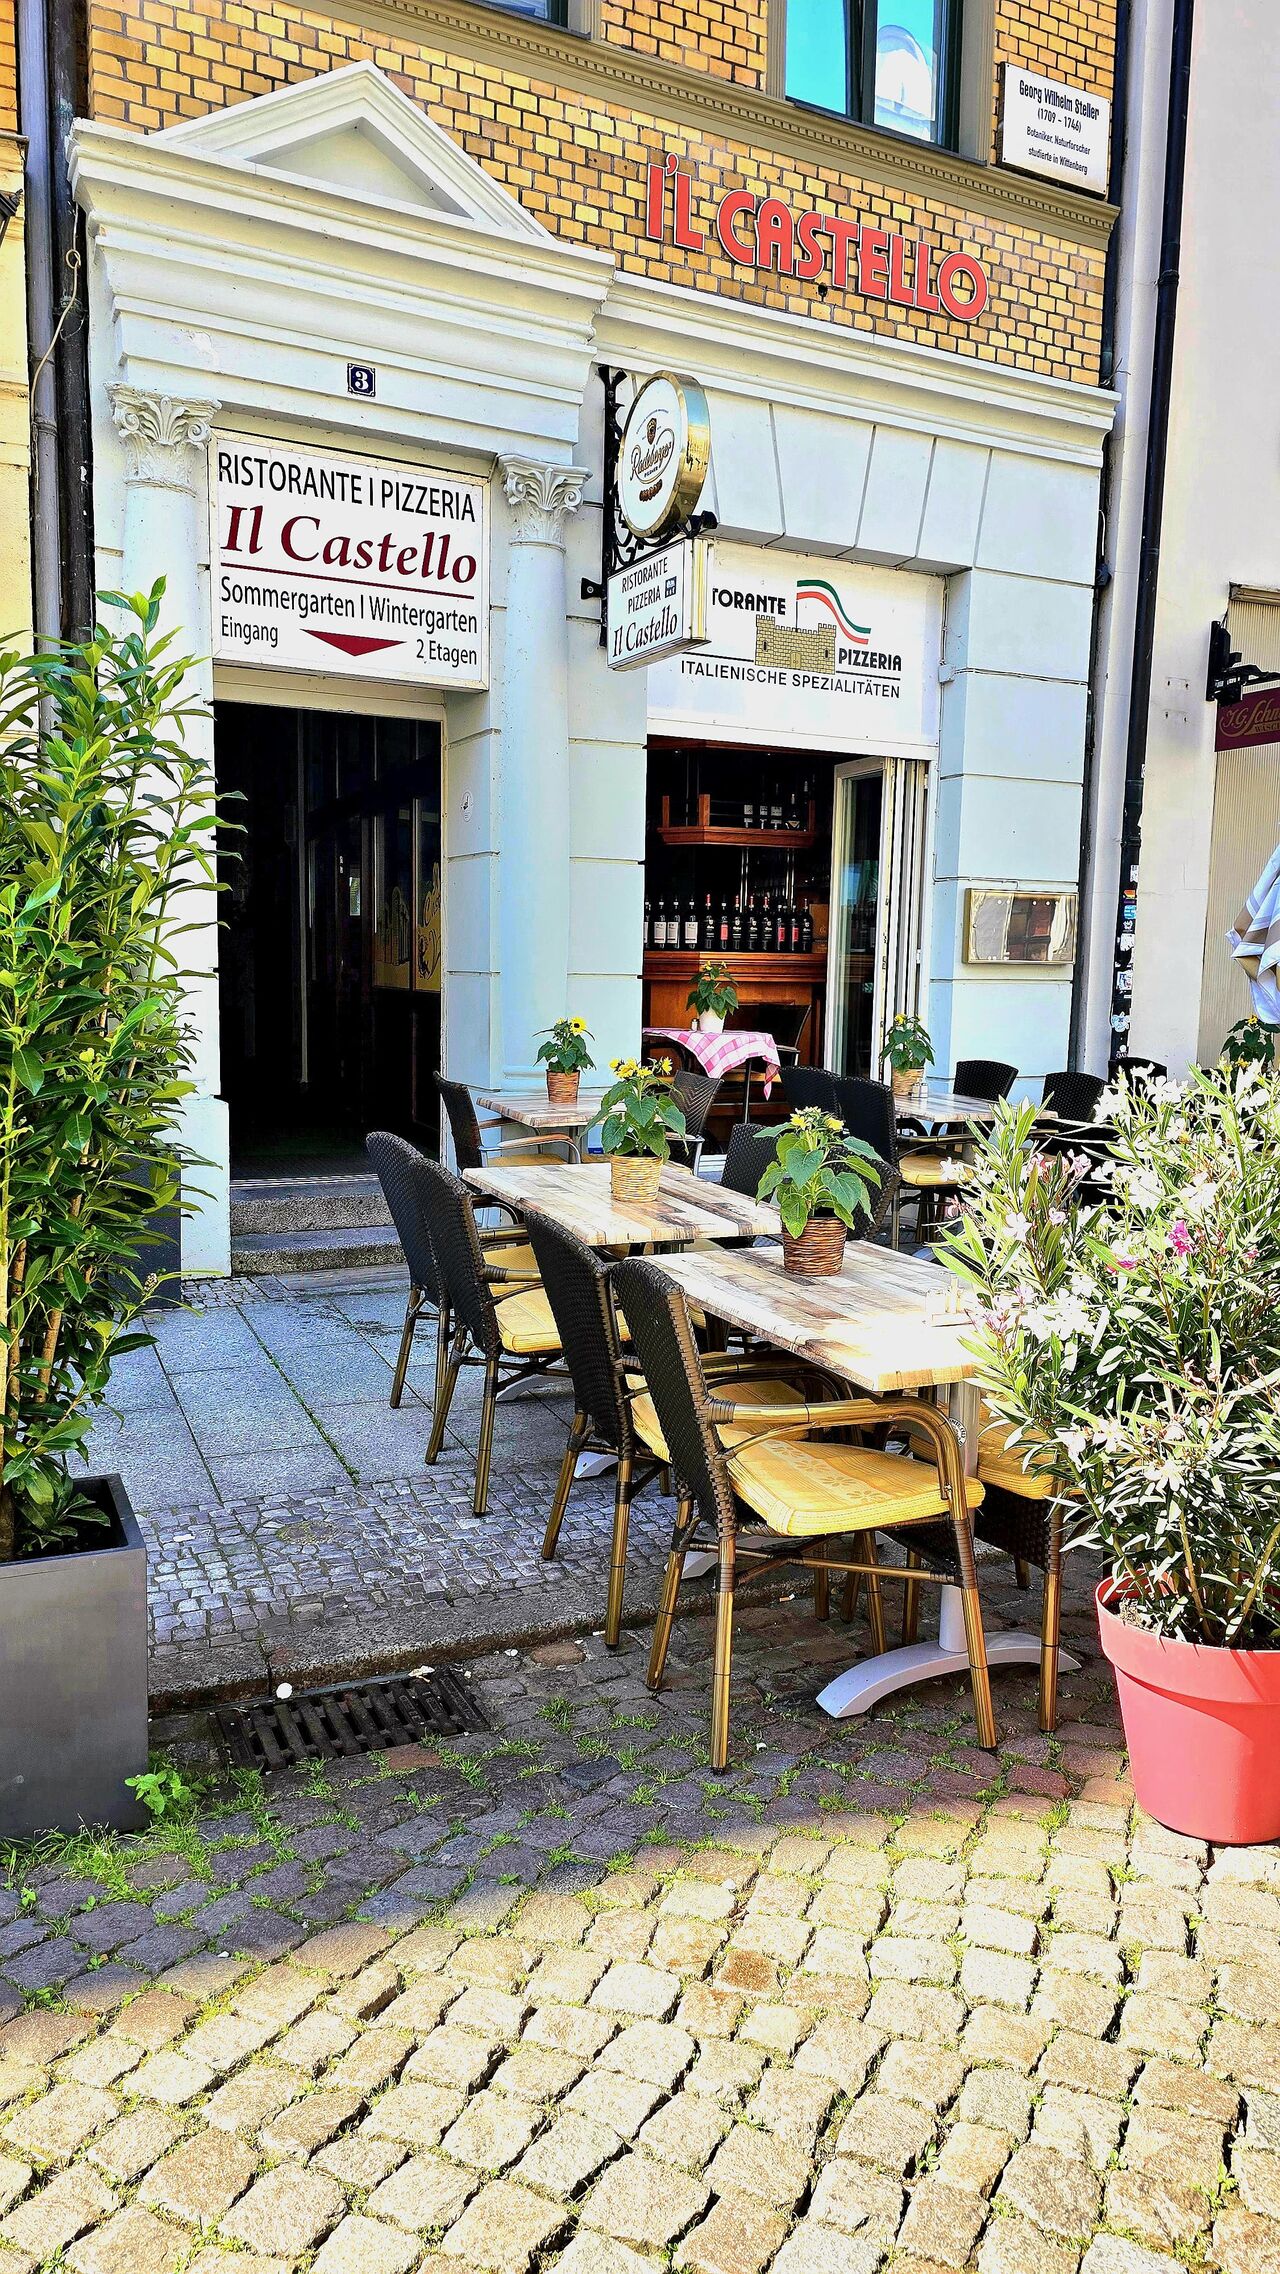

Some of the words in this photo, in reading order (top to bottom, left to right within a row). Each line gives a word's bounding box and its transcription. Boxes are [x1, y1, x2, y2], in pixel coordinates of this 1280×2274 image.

[1019, 79, 1042, 103] Georg
[1044, 88, 1073, 112] Wilhelm
[1075, 98, 1100, 120] Steller
[1037, 107, 1057, 124] (1709
[1064, 116, 1082, 133] 1746)
[1028, 147, 1052, 162] studierte
[1052, 153, 1059, 164] in
[1059, 155, 1088, 176] Wittenberg
[1054, 135, 1090, 155] Naturforscher
[716, 189, 989, 321] CASTELLO
[355, 370, 369, 390] 3
[218, 451, 362, 504] RISTORANTE
[381, 479, 476, 522] PIZZERIA
[220, 504, 264, 554] Il
[280, 515, 477, 583] Castello
[621, 556, 668, 594] RISTORANTE
[221, 575, 355, 619] Sommergarten
[368, 595, 477, 634] Wintergarten
[627, 585, 662, 614] PIZZERIA
[221, 615, 279, 648] Eingang
[612, 624, 623, 658] Il
[625, 604, 678, 652] Castello
[416, 638, 425, 659] 2
[429, 640, 478, 668] Etagen
[838, 647, 902, 672] PIZZERIA
[681, 659, 787, 686] ITALIENISCHE
[792, 673, 900, 699] SPEZIALITÄTEN
